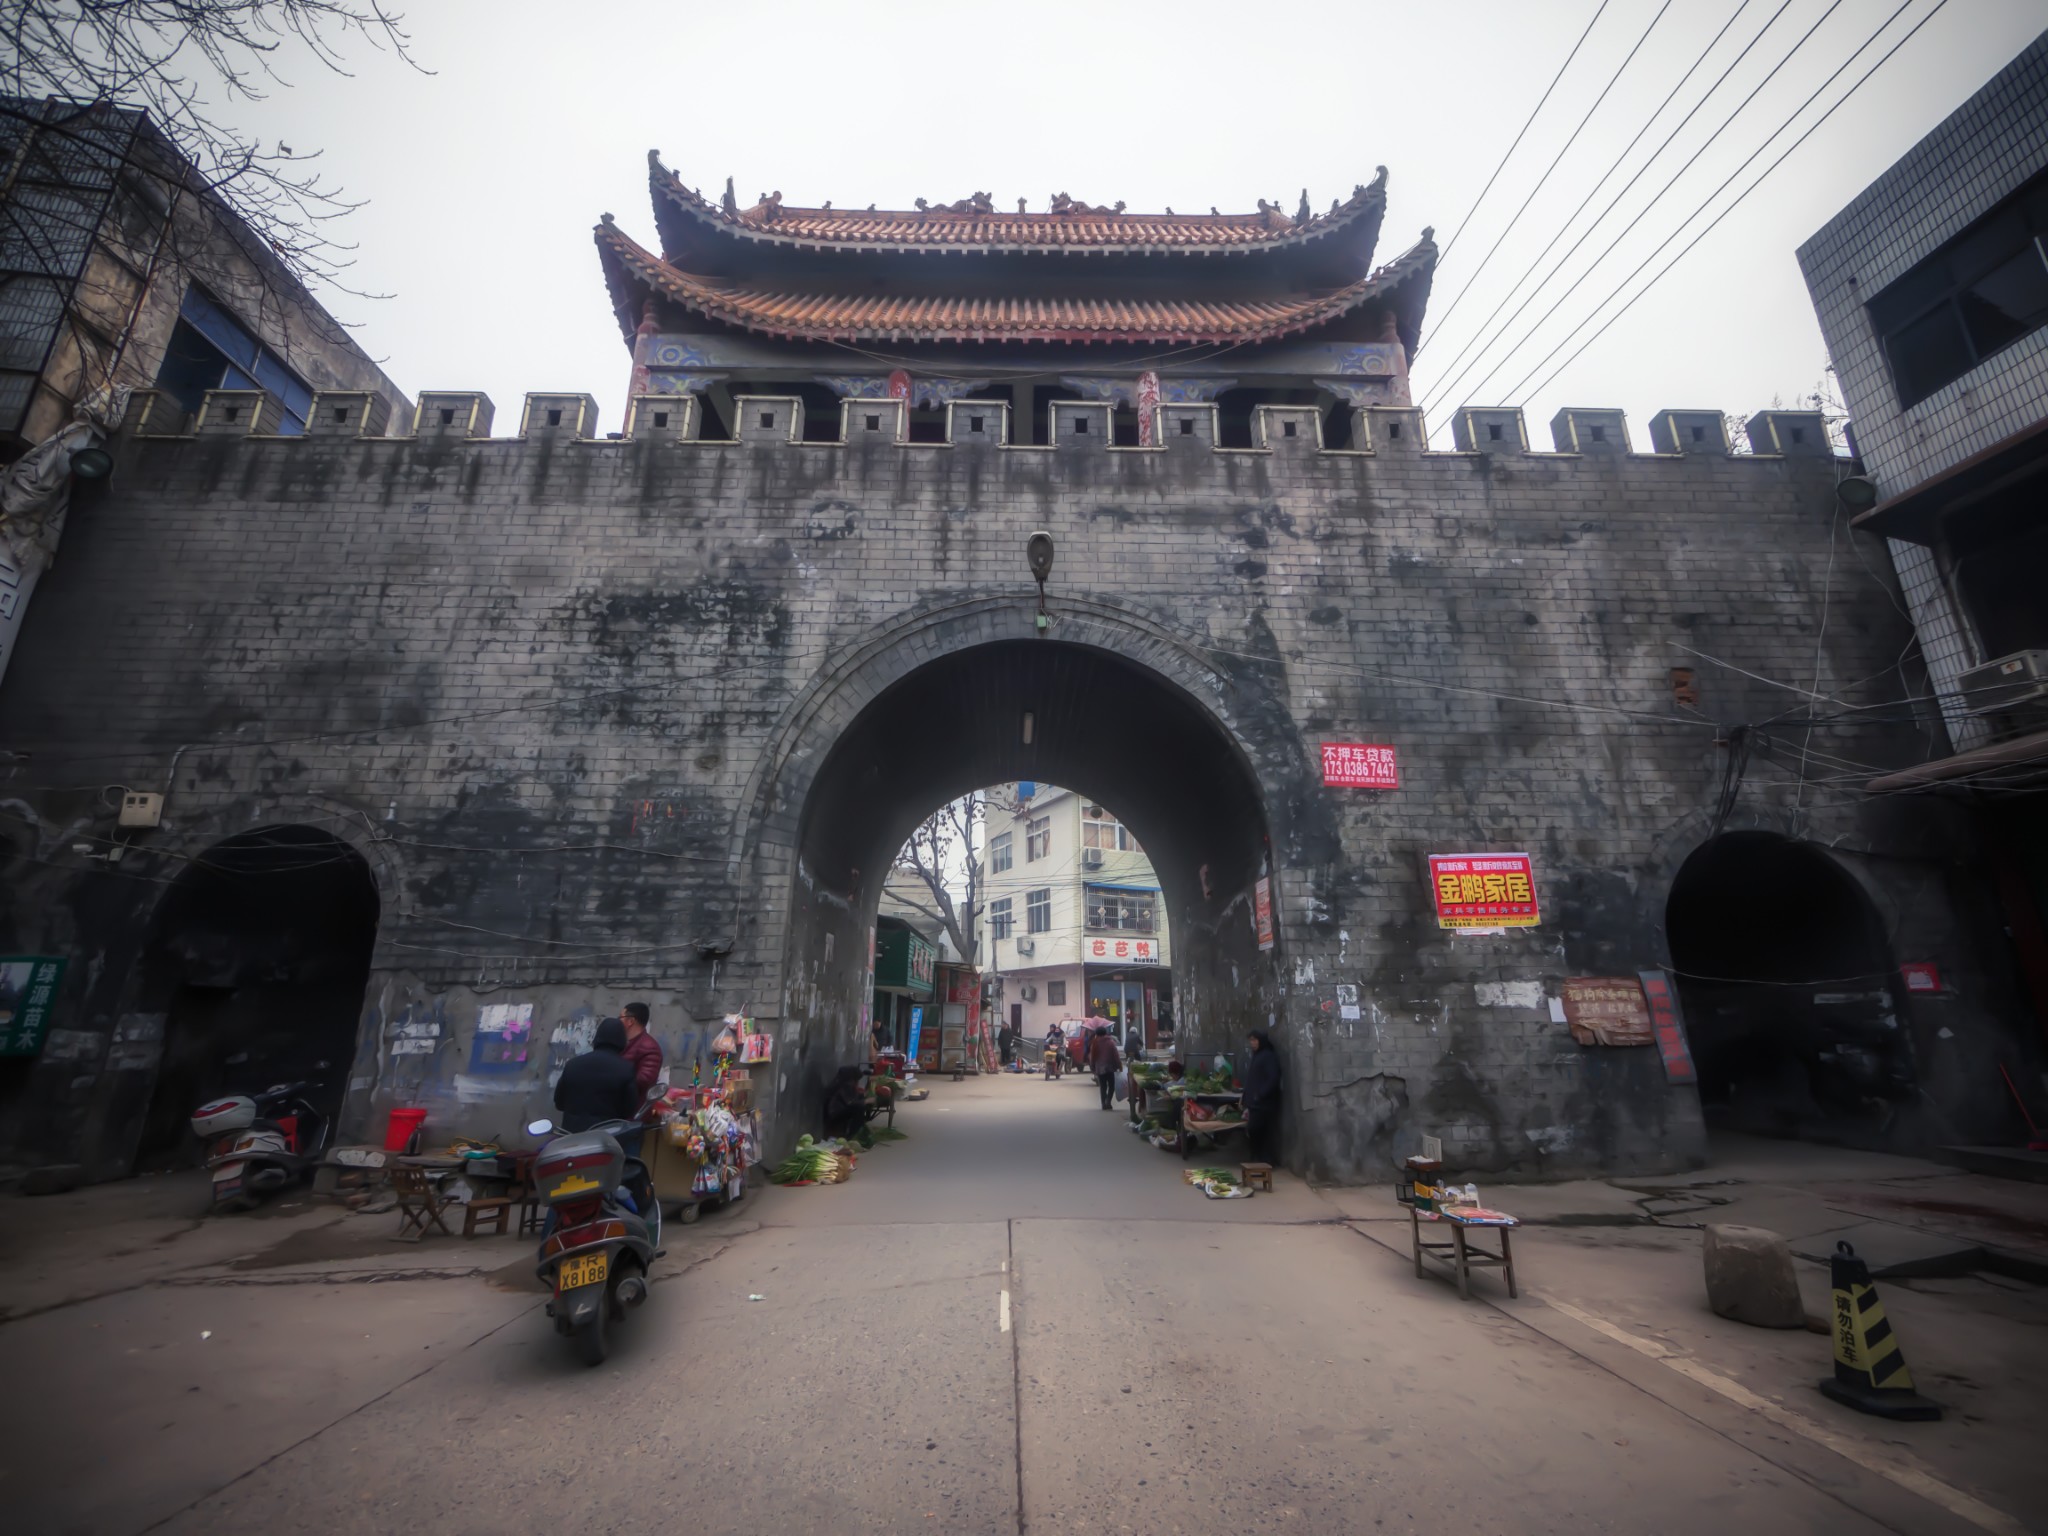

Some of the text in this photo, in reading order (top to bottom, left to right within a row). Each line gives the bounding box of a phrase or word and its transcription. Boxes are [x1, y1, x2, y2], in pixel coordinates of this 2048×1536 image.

[1323, 747, 1394, 762] 不押车贷款
[1324, 760, 1395, 777] 173 0386 7447
[1438, 873, 1532, 904] 金鹏家居
[1443, 906, 1532, 915] 家具零售服务专家
[1092, 940, 1150, 958] 芭芭鸭
[15, 963, 57, 1050] 绿源苗木
[562, 1265, 605, 1289] X8188
[1836, 1295, 1858, 1362] 请勿泊车
